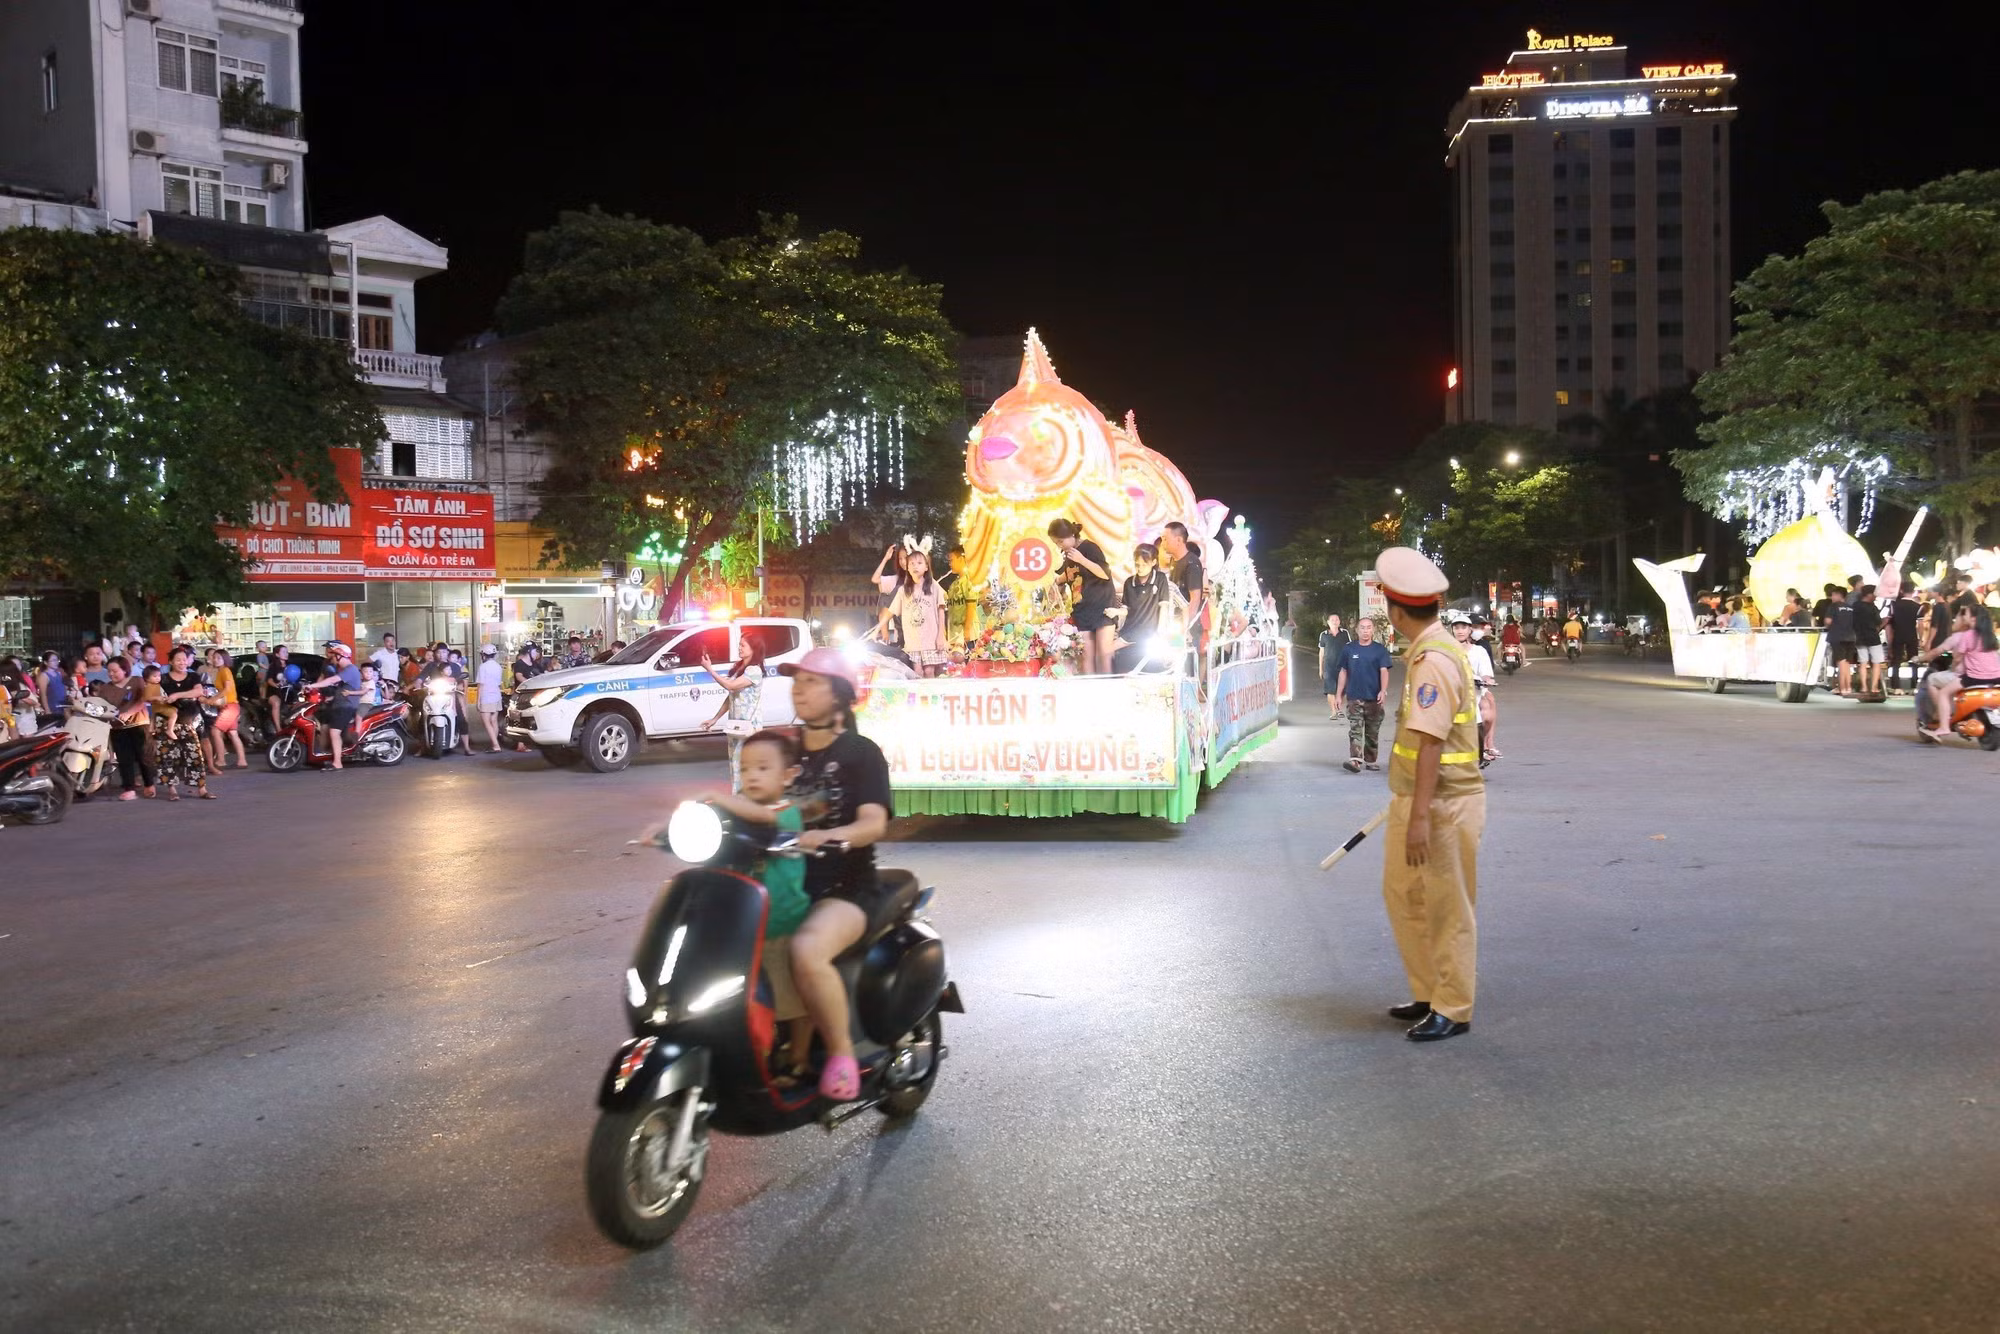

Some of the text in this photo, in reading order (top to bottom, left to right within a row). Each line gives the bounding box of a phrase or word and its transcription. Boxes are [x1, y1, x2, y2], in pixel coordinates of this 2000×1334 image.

[1528, 33, 1613, 50] Royal Palace
[1482, 72, 1545, 86] HOTEL
[1642, 66, 1682, 79] VIEW
[394, 495, 466, 515] TÂM ÁNH
[376, 518, 485, 549] ĐỒ SƠ SINH
[286, 536, 315, 554] THÔNG
[318, 540, 340, 555] MINH
[422, 553, 438, 566] ÁO
[460, 556, 475, 566] EM
[1015, 546, 1047, 571] 13
[596, 681, 629, 692] CẢNH
[674, 673, 695, 685] SÁT
[659, 688, 727, 701] TRAFFIC POLICE
[943, 687, 1028, 726] THÔN
